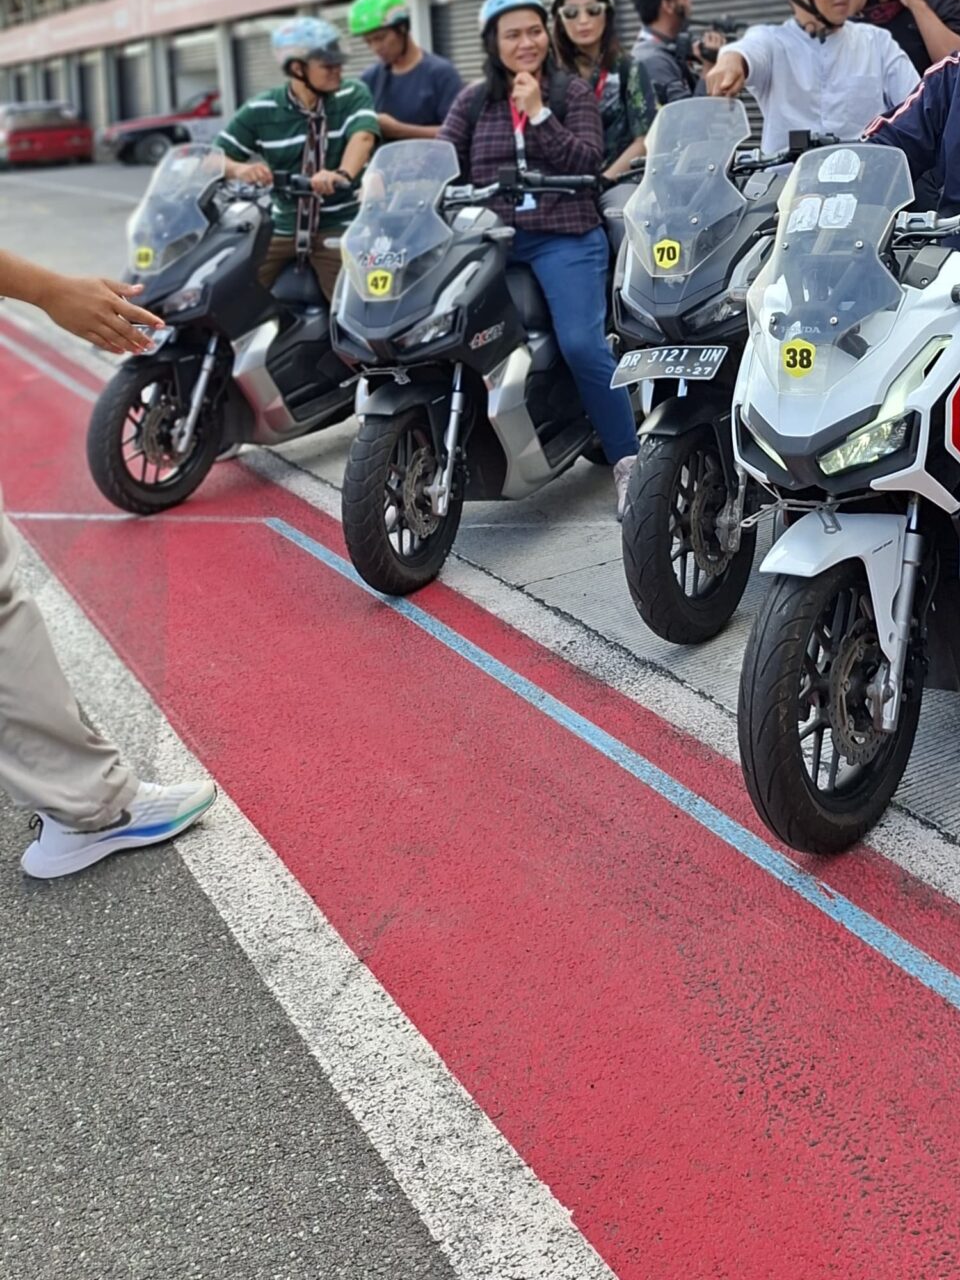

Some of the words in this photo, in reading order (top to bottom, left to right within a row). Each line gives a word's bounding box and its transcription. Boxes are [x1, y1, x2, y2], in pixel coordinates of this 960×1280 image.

[656, 246, 677, 263] 70
[370, 276, 389, 290] 47
[621, 353, 642, 368] DR
[647, 348, 689, 363] 3121
[699, 348, 723, 363] UN
[786, 347, 812, 369] 38
